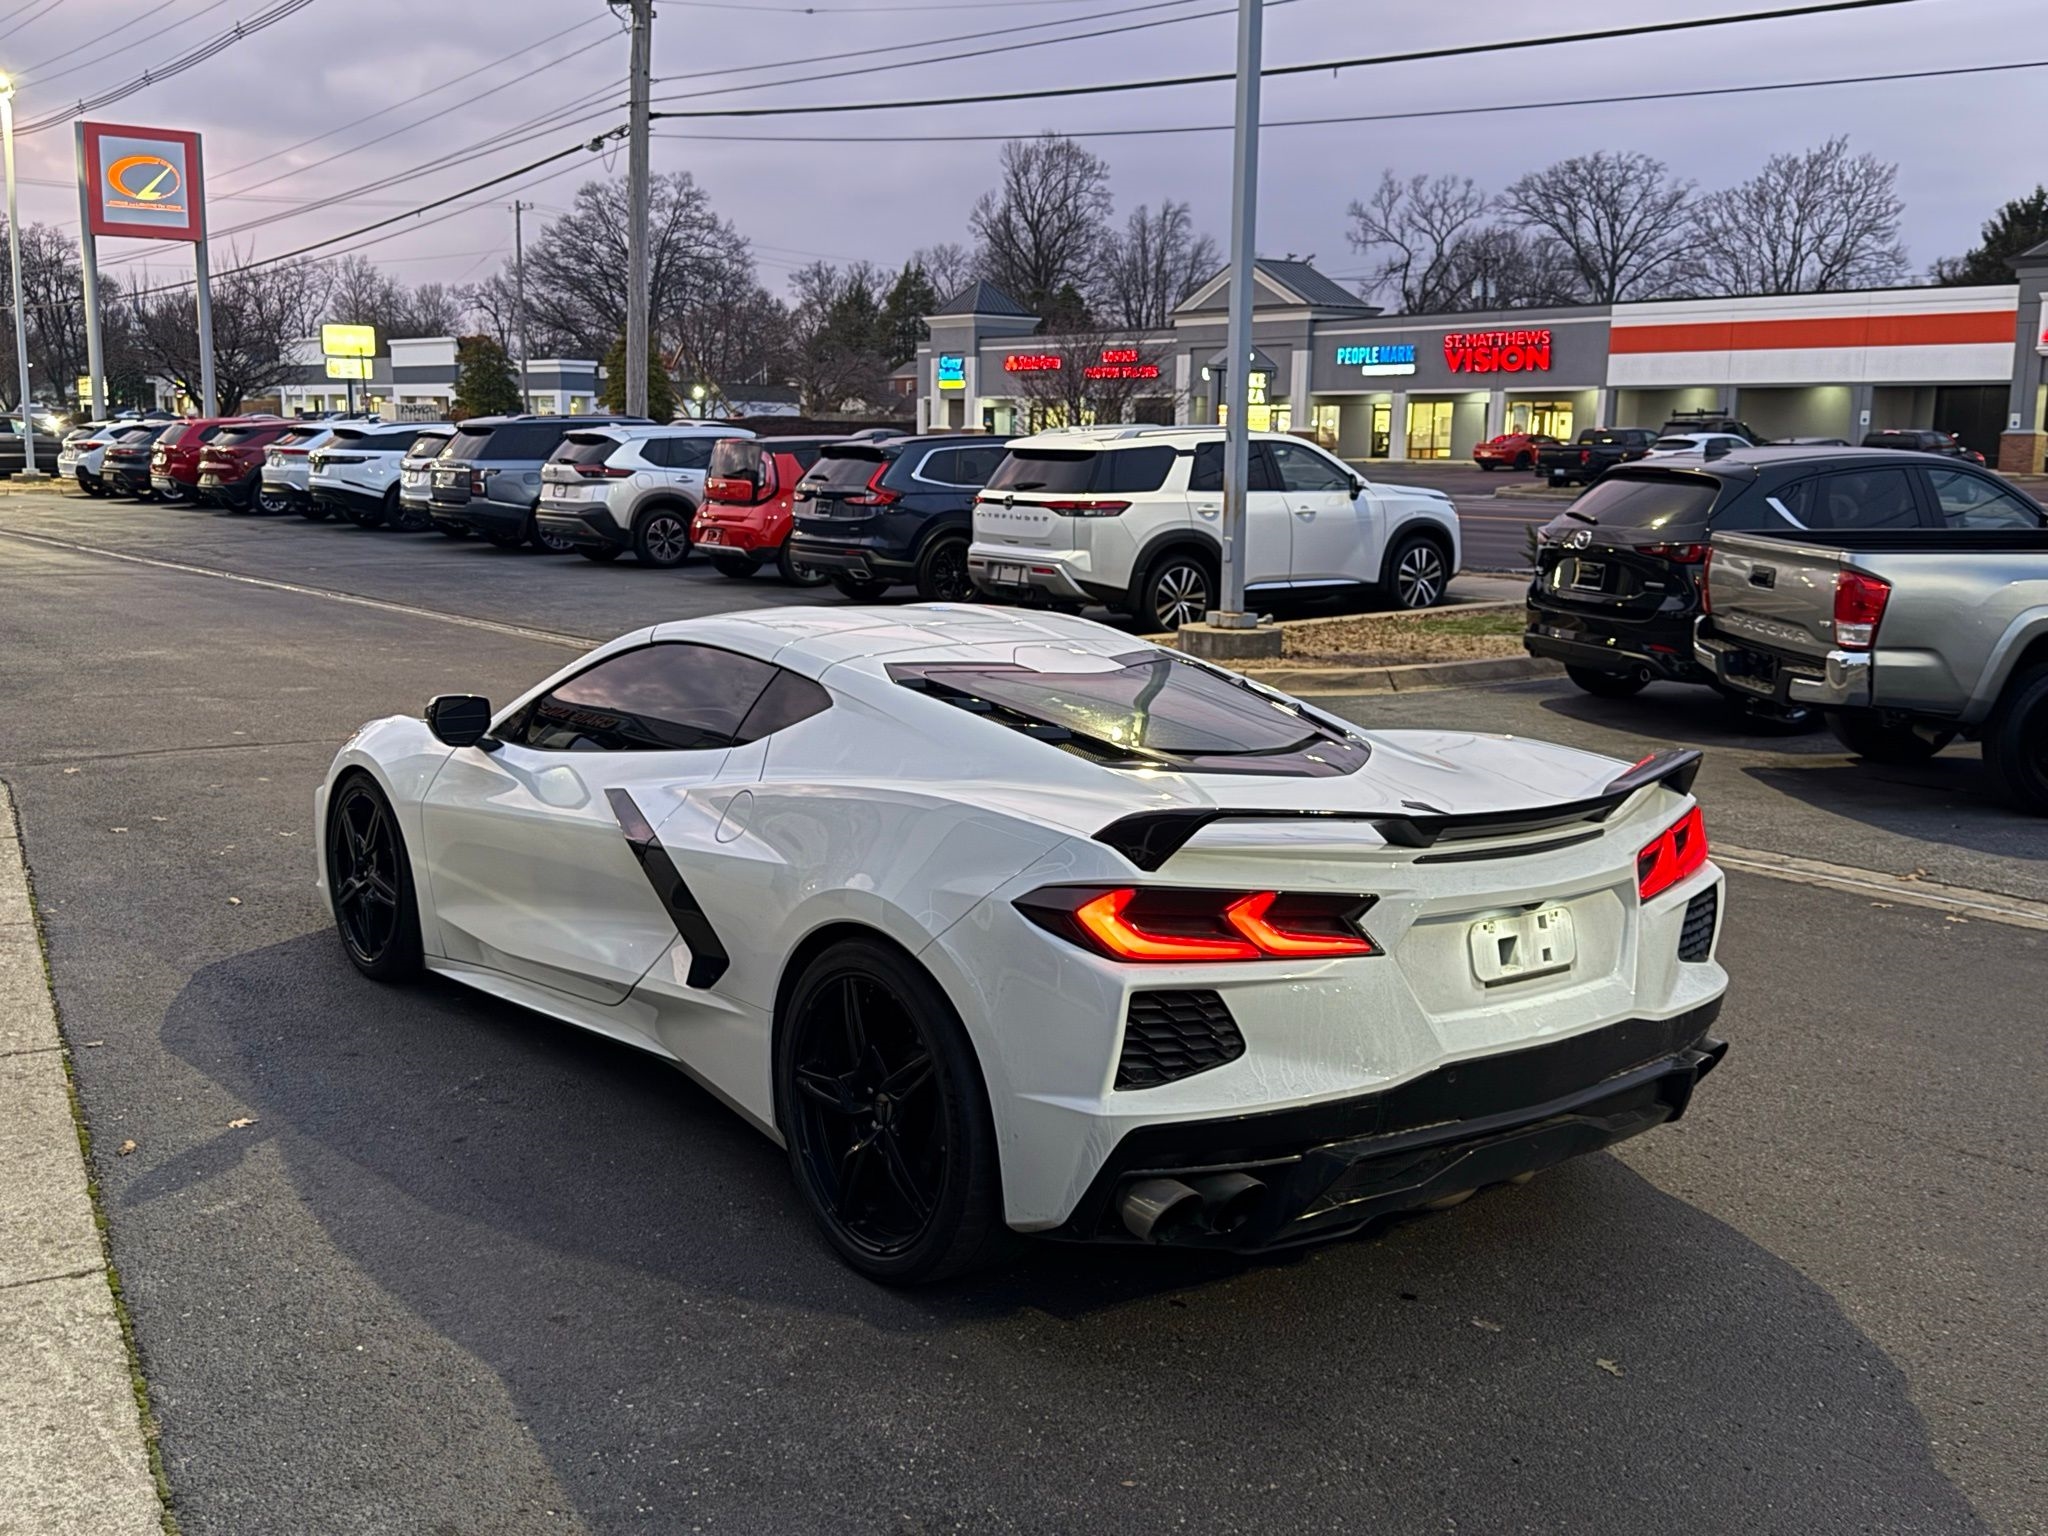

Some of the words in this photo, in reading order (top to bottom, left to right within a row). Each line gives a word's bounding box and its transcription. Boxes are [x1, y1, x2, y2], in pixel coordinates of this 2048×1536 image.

[1444, 346, 1550, 372] VISION
[976, 512, 1049, 522] PATHFINDER
[1730, 615, 1807, 643] TACOMA
